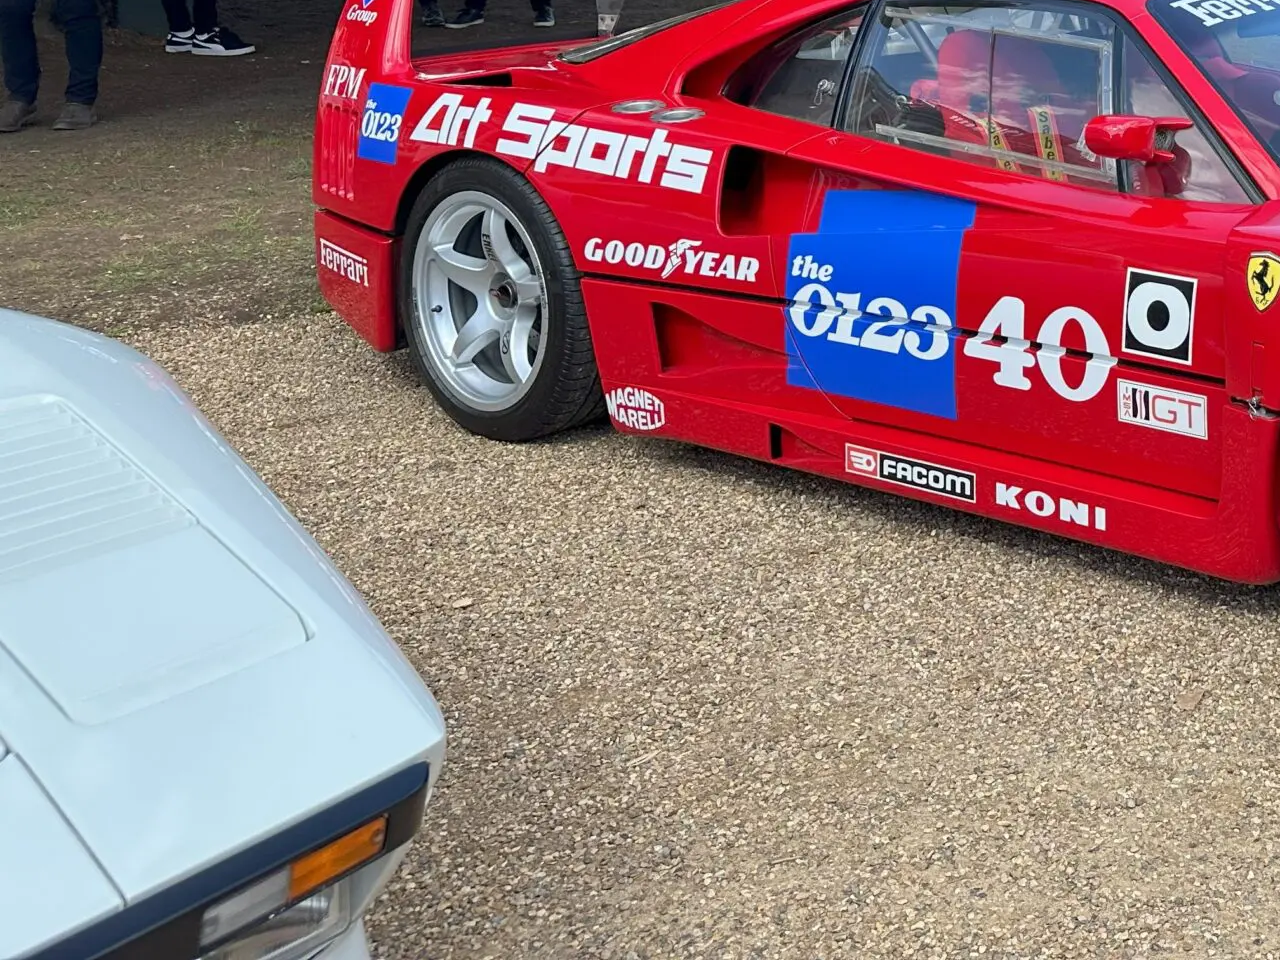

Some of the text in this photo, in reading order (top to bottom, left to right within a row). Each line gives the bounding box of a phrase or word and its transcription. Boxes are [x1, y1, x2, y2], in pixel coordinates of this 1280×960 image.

[346, 4, 378, 27] Group
[323, 64, 367, 100] FPM
[365, 99, 378, 109] the
[361, 109, 403, 143] 0123
[409, 92, 714, 194] Art Sports
[319, 237, 369, 287] Ferrari
[790, 254, 834, 282] the
[789, 283, 953, 361] 0123
[963, 295, 1115, 402] 40
[1122, 385, 1202, 429] IMSA GT
[882, 459, 972, 496] FACOM
[995, 482, 1107, 532] KONI
